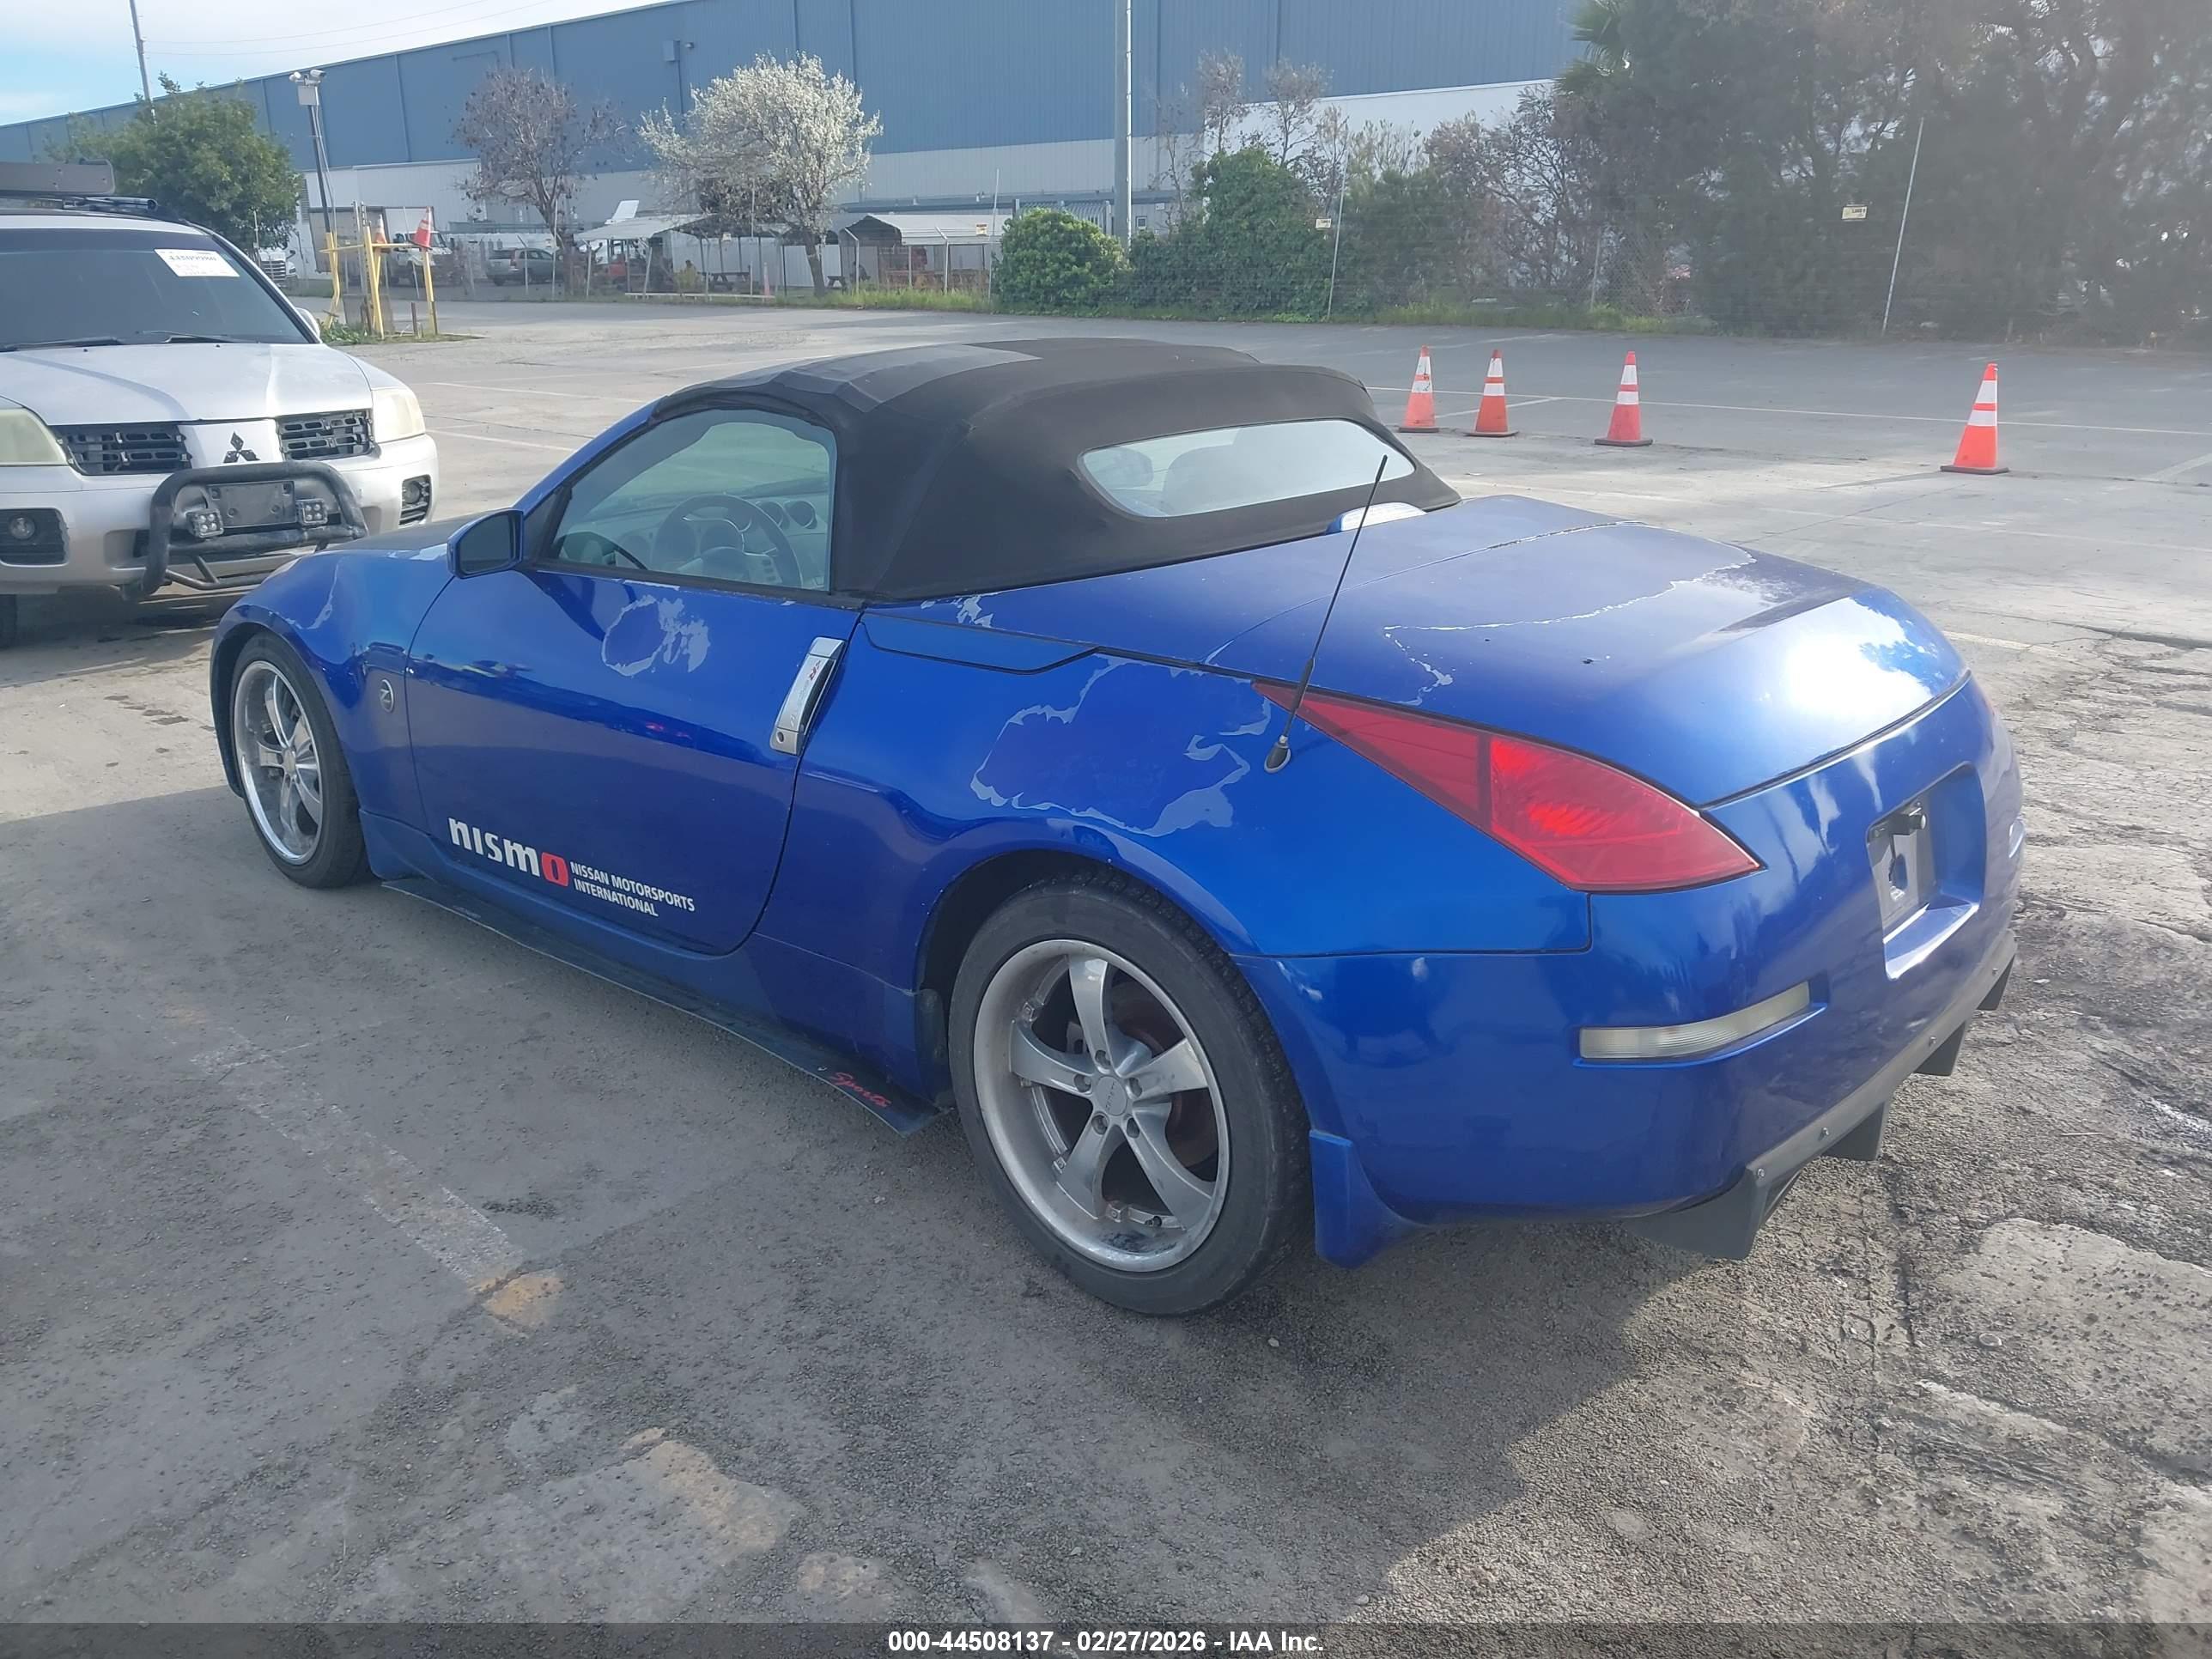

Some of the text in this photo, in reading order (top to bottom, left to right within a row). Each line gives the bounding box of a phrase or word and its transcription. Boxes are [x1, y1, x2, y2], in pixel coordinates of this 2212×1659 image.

[570, 861, 696, 913] NISSAN MOTORSPORTS
[573, 878, 659, 917] INTERNATIONAL
